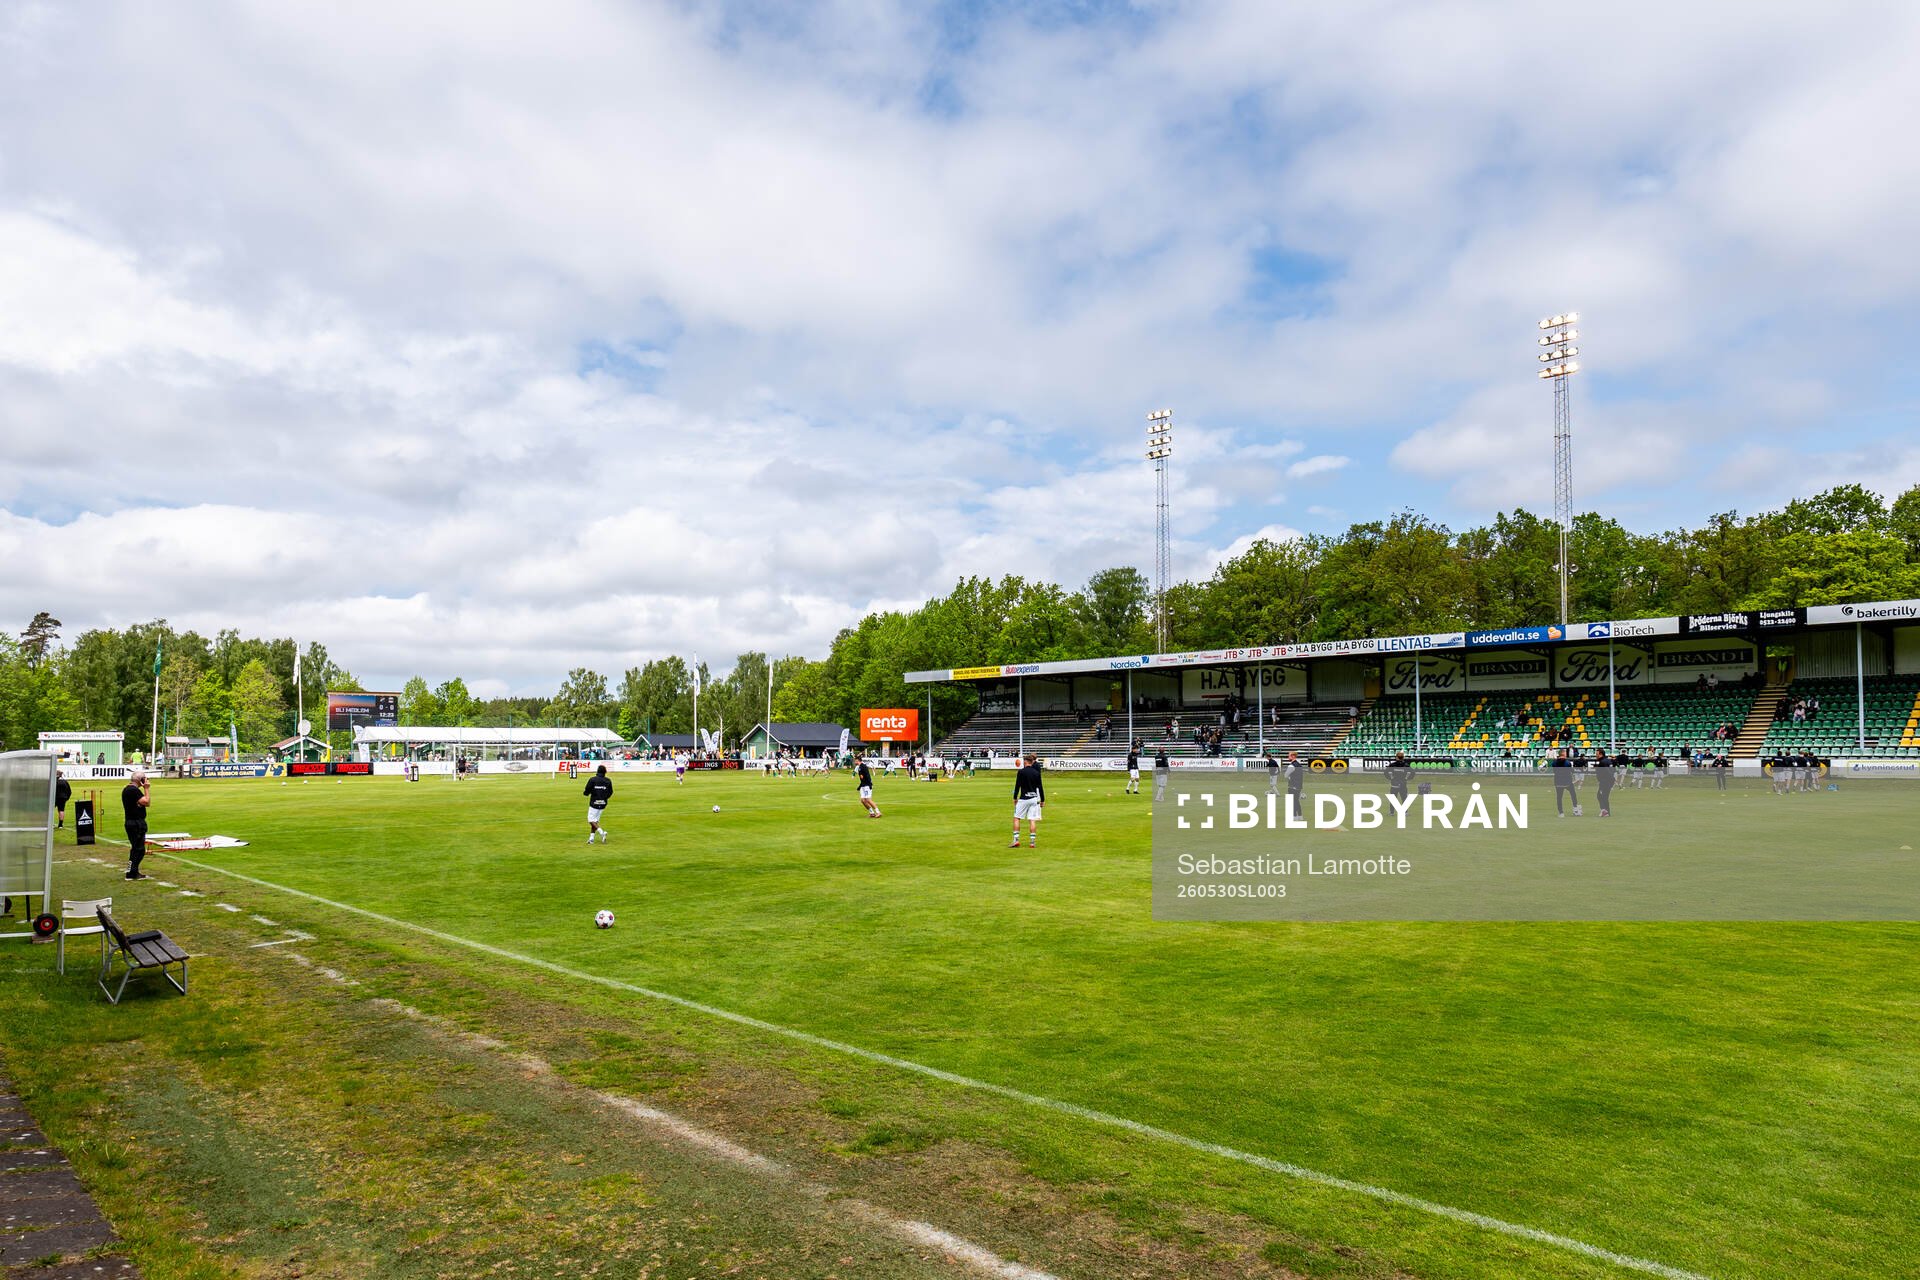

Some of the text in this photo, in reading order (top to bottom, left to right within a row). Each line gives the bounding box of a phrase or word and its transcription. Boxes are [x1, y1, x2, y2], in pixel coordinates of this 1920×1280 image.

[1760, 611, 1794, 619] Ljungskile
[1857, 605, 1917, 618] bakertilly
[1689, 613, 1748, 629] Bröderna Björks
[1613, 625, 1655, 637] BioTech
[1700, 624, 1737, 632] Bilservice
[1472, 630, 1540, 644] uddevalla.se
[1311, 642, 1333, 652] BYGG
[1352, 639, 1374, 650] BYGG
[1377, 636, 1432, 651] LLENTAB
[1224, 650, 1238, 660] JTB
[1248, 649, 1262, 658] JTB
[1271, 647, 1287, 657] JTB
[1005, 665, 1040, 674] Autoexperten
[1110, 661, 1141, 669] Nordea
[1474, 661, 1543, 674] BRANDT
[1559, 650, 1642, 683] Ford
[1234, 667, 1286, 689] BYGG
[1388, 660, 1456, 690] Ford
[866, 715, 907, 728] renta
[722, 760, 739, 769] 1803
[1471, 759, 1534, 773] SUPERETTAN
[1861, 764, 1915, 772] kynningsrud
[92, 767, 125, 777] PUMA
